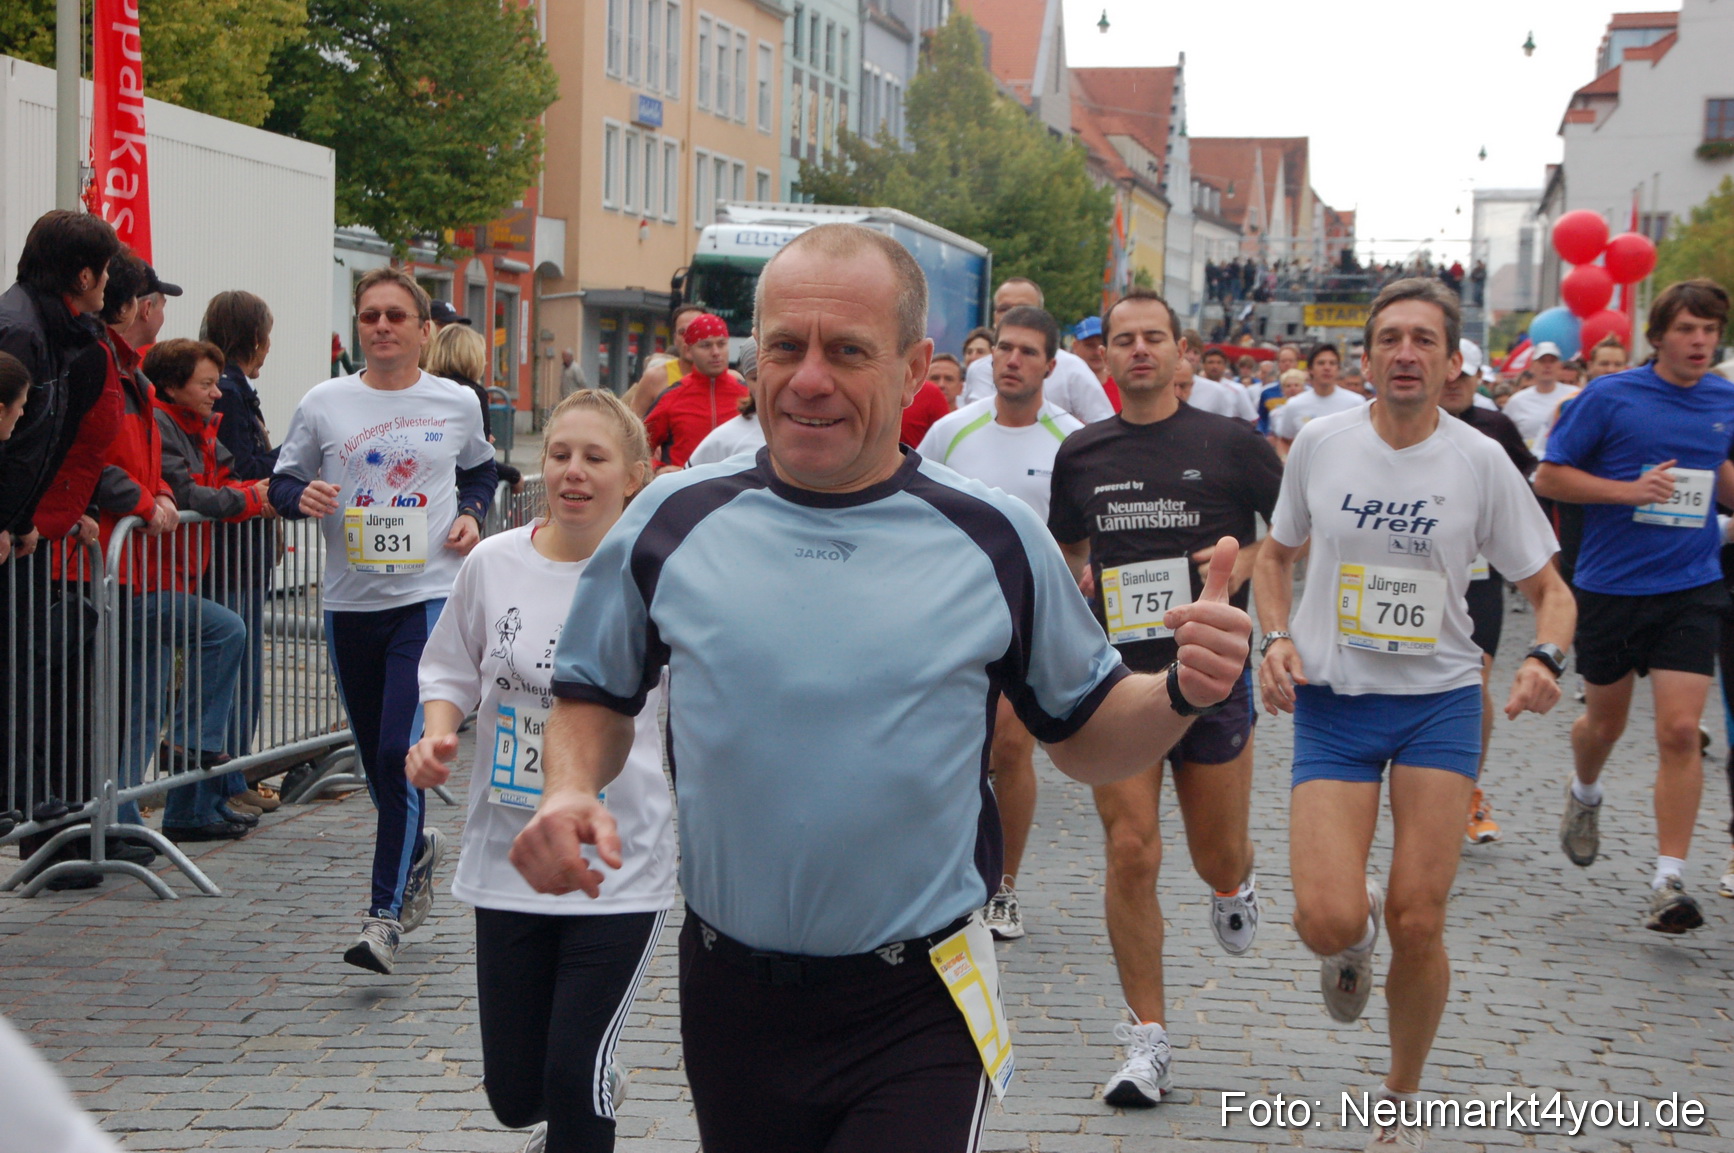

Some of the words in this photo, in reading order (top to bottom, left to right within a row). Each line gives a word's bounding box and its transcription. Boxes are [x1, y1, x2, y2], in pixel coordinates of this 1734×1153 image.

[102, 0, 146, 233] parkas
[394, 416, 447, 430] Silvesterlauf
[343, 420, 393, 456] Nürnberger
[424, 432, 444, 442] 2007
[339, 449, 348, 466] 5.
[1094, 481, 1130, 495] powered
[1132, 480, 1144, 491] by
[391, 495, 418, 507] tkn
[1107, 498, 1186, 514] Neumarkter
[1341, 493, 1427, 517] Lauf
[366, 513, 404, 529] Jürgen
[1096, 511, 1200, 532] Lammsbräu
[1354, 510, 1439, 535] Treff
[348, 532, 354, 542] B
[374, 534, 411, 552] 831
[794, 547, 840, 560] JAKO
[1122, 569, 1169, 586] Gianluca
[1367, 574, 1417, 596] Jürgen
[1131, 590, 1173, 614] 757
[1342, 596, 1349, 608] B
[1376, 601, 1425, 628] 706
[496, 677, 519, 690] 9.
[521, 682, 552, 697] Neu
[502, 740, 509, 754] B
[523, 746, 544, 774] 2
